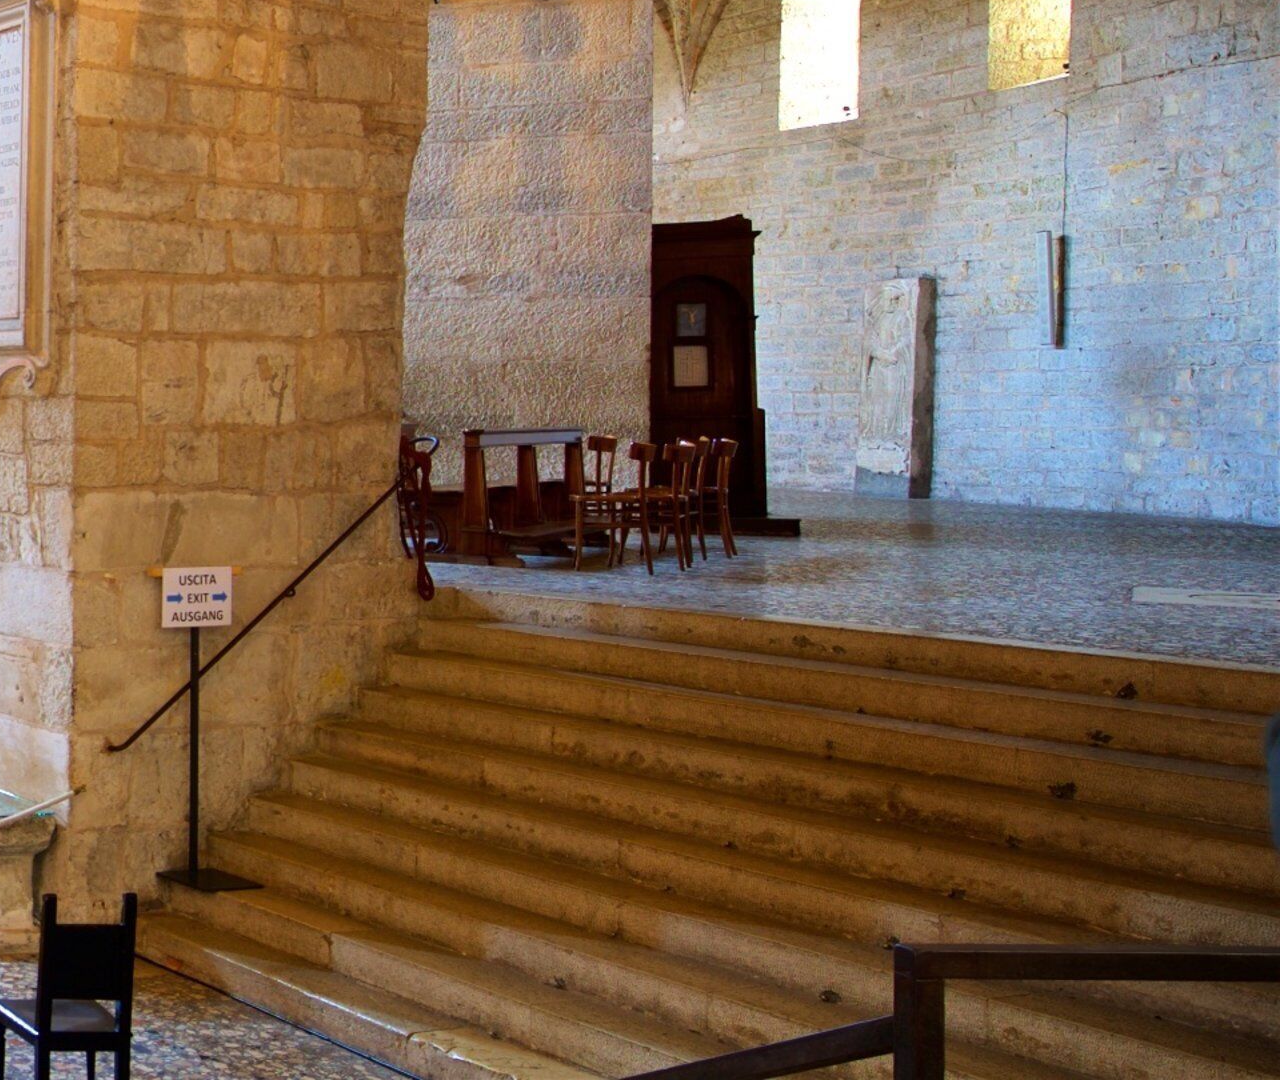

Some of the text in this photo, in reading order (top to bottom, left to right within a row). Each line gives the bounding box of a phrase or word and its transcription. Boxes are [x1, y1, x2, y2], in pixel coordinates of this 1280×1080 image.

[178, 574, 217, 586] USCITA
[187, 593, 209, 603] EXIT
[171, 610, 224, 622] AUSGANG
